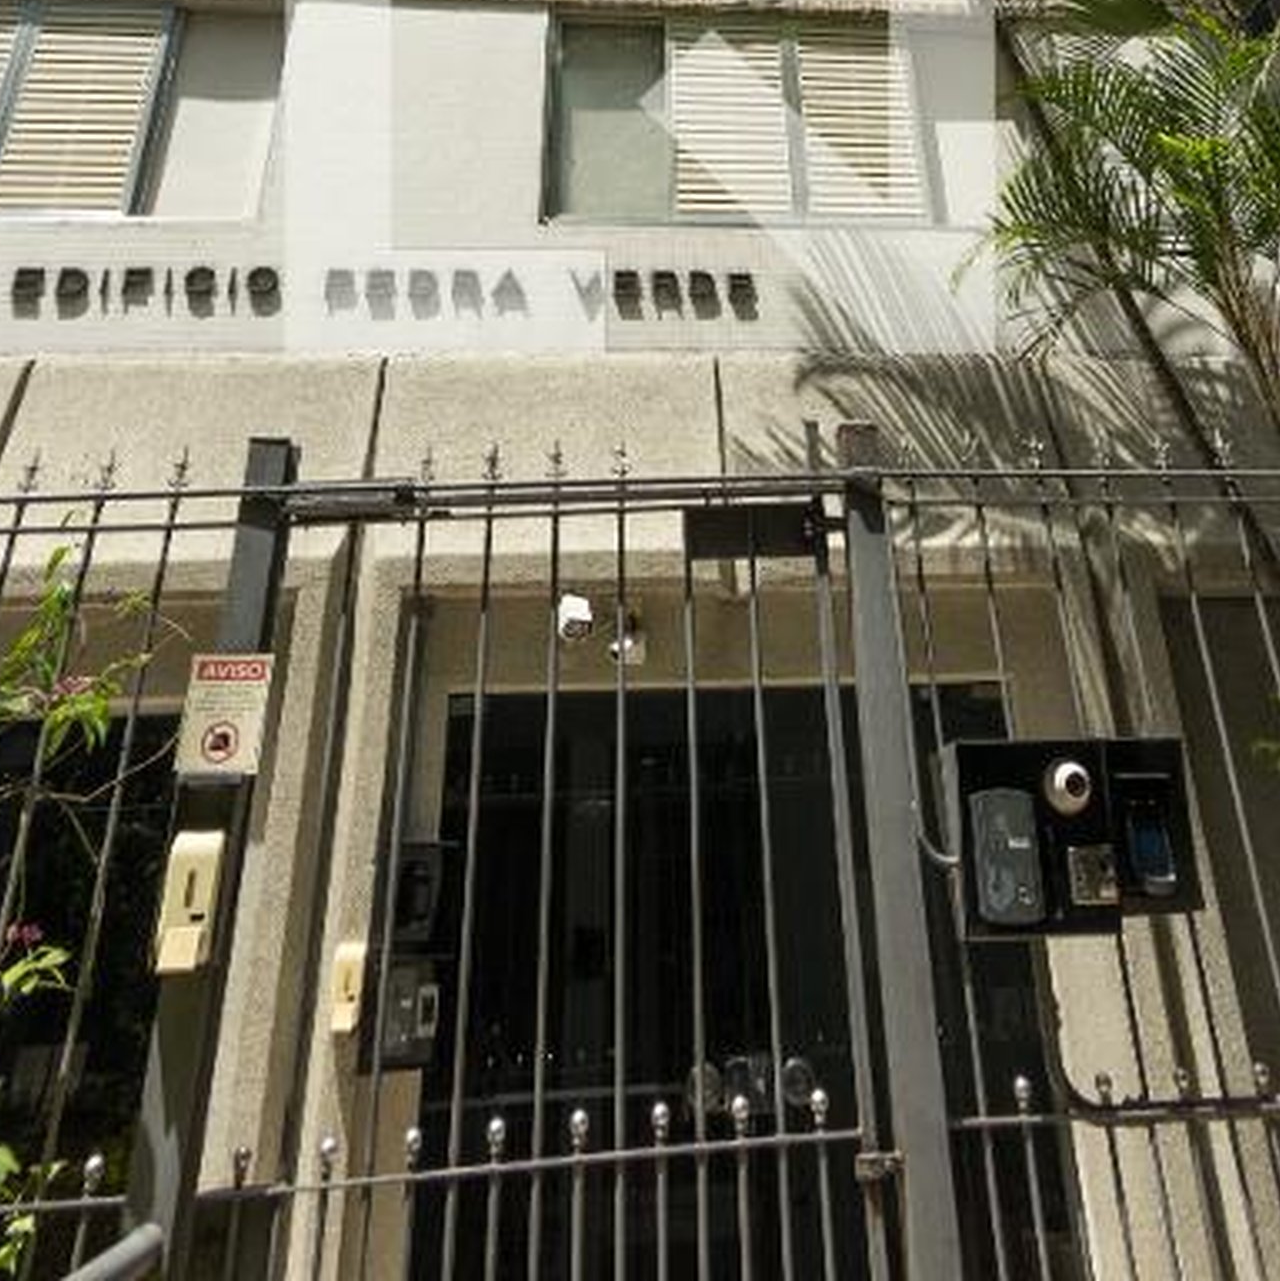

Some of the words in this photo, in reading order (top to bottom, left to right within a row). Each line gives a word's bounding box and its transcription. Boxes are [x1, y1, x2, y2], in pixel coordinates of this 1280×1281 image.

[11, 266, 282, 318] EDIFICIO
[569, 270, 759, 320] VERDE
[201, 662, 263, 679] AVISO
